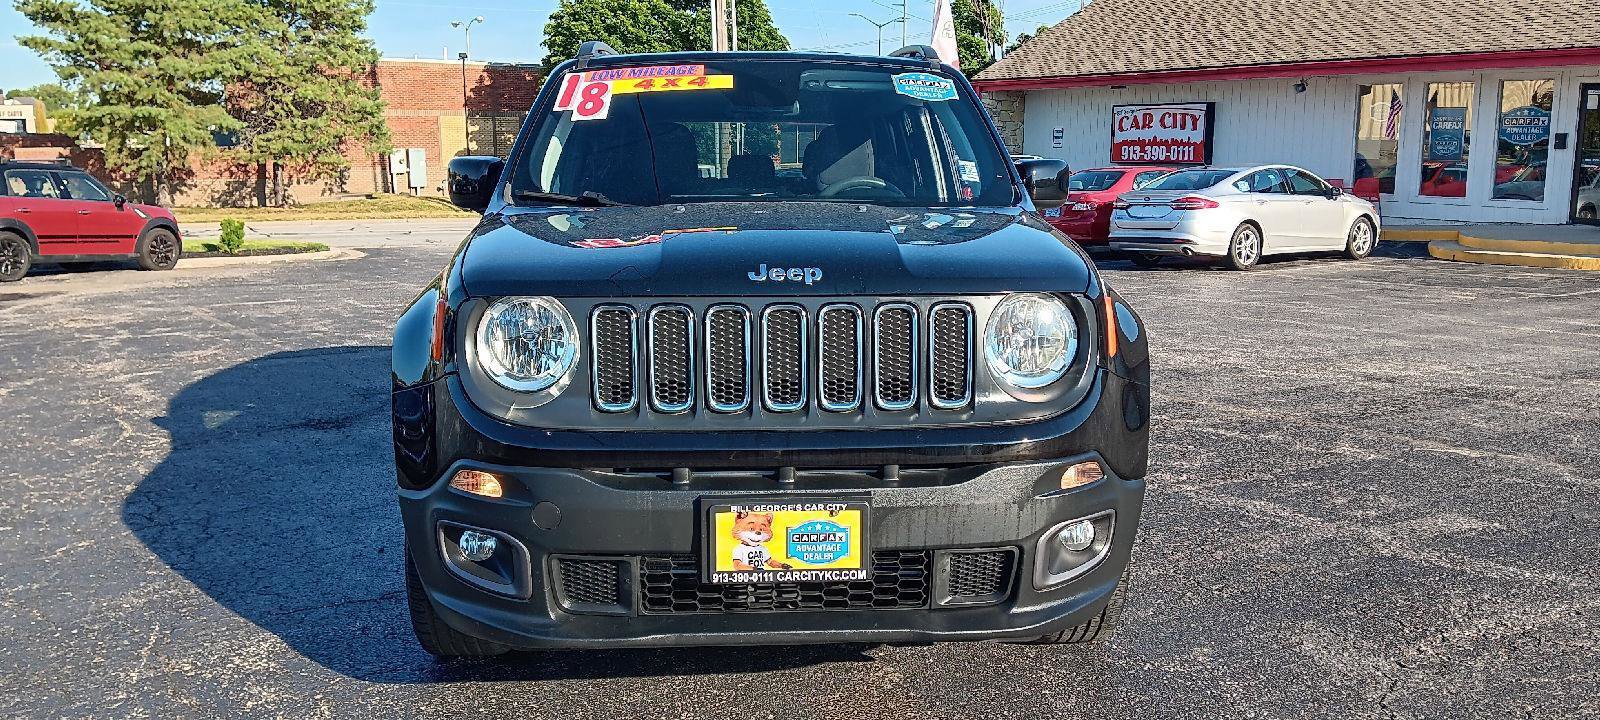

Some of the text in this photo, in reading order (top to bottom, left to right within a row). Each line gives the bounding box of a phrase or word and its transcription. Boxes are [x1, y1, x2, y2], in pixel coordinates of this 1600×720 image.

[591, 65, 700, 81] LOW MILEAGE
[899, 79, 951, 89] CARFAX
[905, 85, 949, 94] ADVANTAGE
[1118, 112, 1154, 132] CAR
[1159, 111, 1201, 132] CITY
[1432, 121, 1463, 130] CARFAX
[1503, 116, 1549, 126] CARFAX
[1505, 126, 1544, 134] ADVANTAGE
[1511, 133, 1537, 141] DEALER
[1121, 145, 1195, 161] 913-390-0111
[747, 263, 823, 285] Jeep
[753, 504, 803, 512] GEORGE'S
[828, 503, 848, 511] CITY
[791, 532, 846, 543] CARFAX
[795, 544, 842, 553] ADVANTAGE
[747, 550, 764, 560] CAR
[803, 552, 834, 561] DEALER
[748, 559, 764, 568] FOX
[712, 570, 867, 583] 913-390-0111 CARCITYKC.COM
